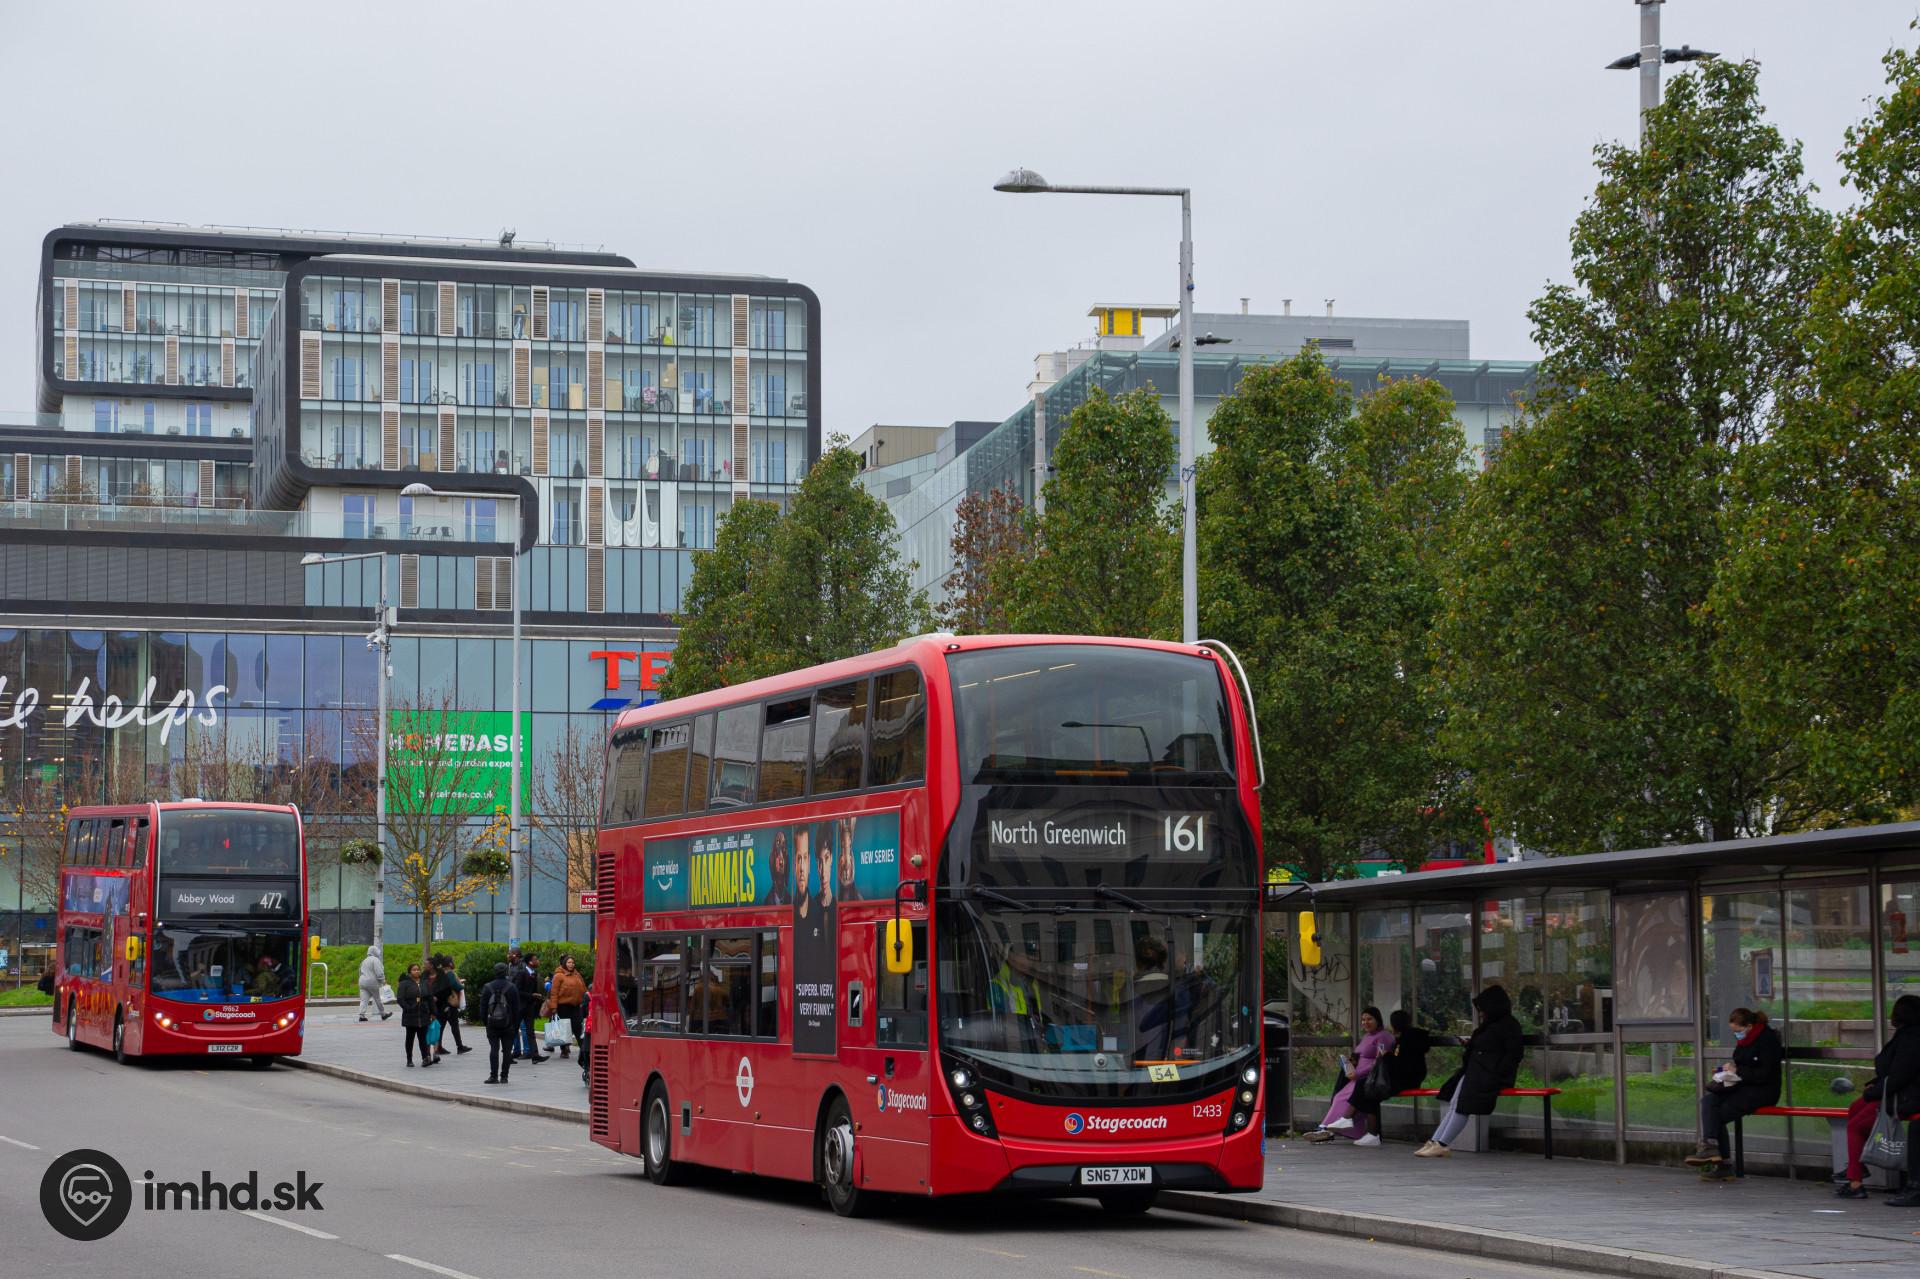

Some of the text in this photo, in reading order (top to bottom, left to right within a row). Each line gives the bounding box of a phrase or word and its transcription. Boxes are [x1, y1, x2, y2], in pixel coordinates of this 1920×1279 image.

[64, 676, 229, 745] helps
[991, 815, 1203, 851] North Greenwich 161
[860, 849, 894, 864] NEW SERIES
[652, 860, 679, 880] prime video
[691, 848, 755, 905] MAMMALS
[178, 893, 282, 909] Abbey Wood 472
[820, 984, 834, 999] VERY,
[215, 1010, 256, 1019] Stagecoach
[800, 1003, 814, 1016] VERY
[1154, 1069, 1175, 1081] 54
[888, 1089, 927, 1113] Stagecoach
[1192, 1104, 1222, 1118] 12433
[1087, 1113, 1168, 1134] Stagecoach
[1086, 1168, 1147, 1182] SN67 XDW
